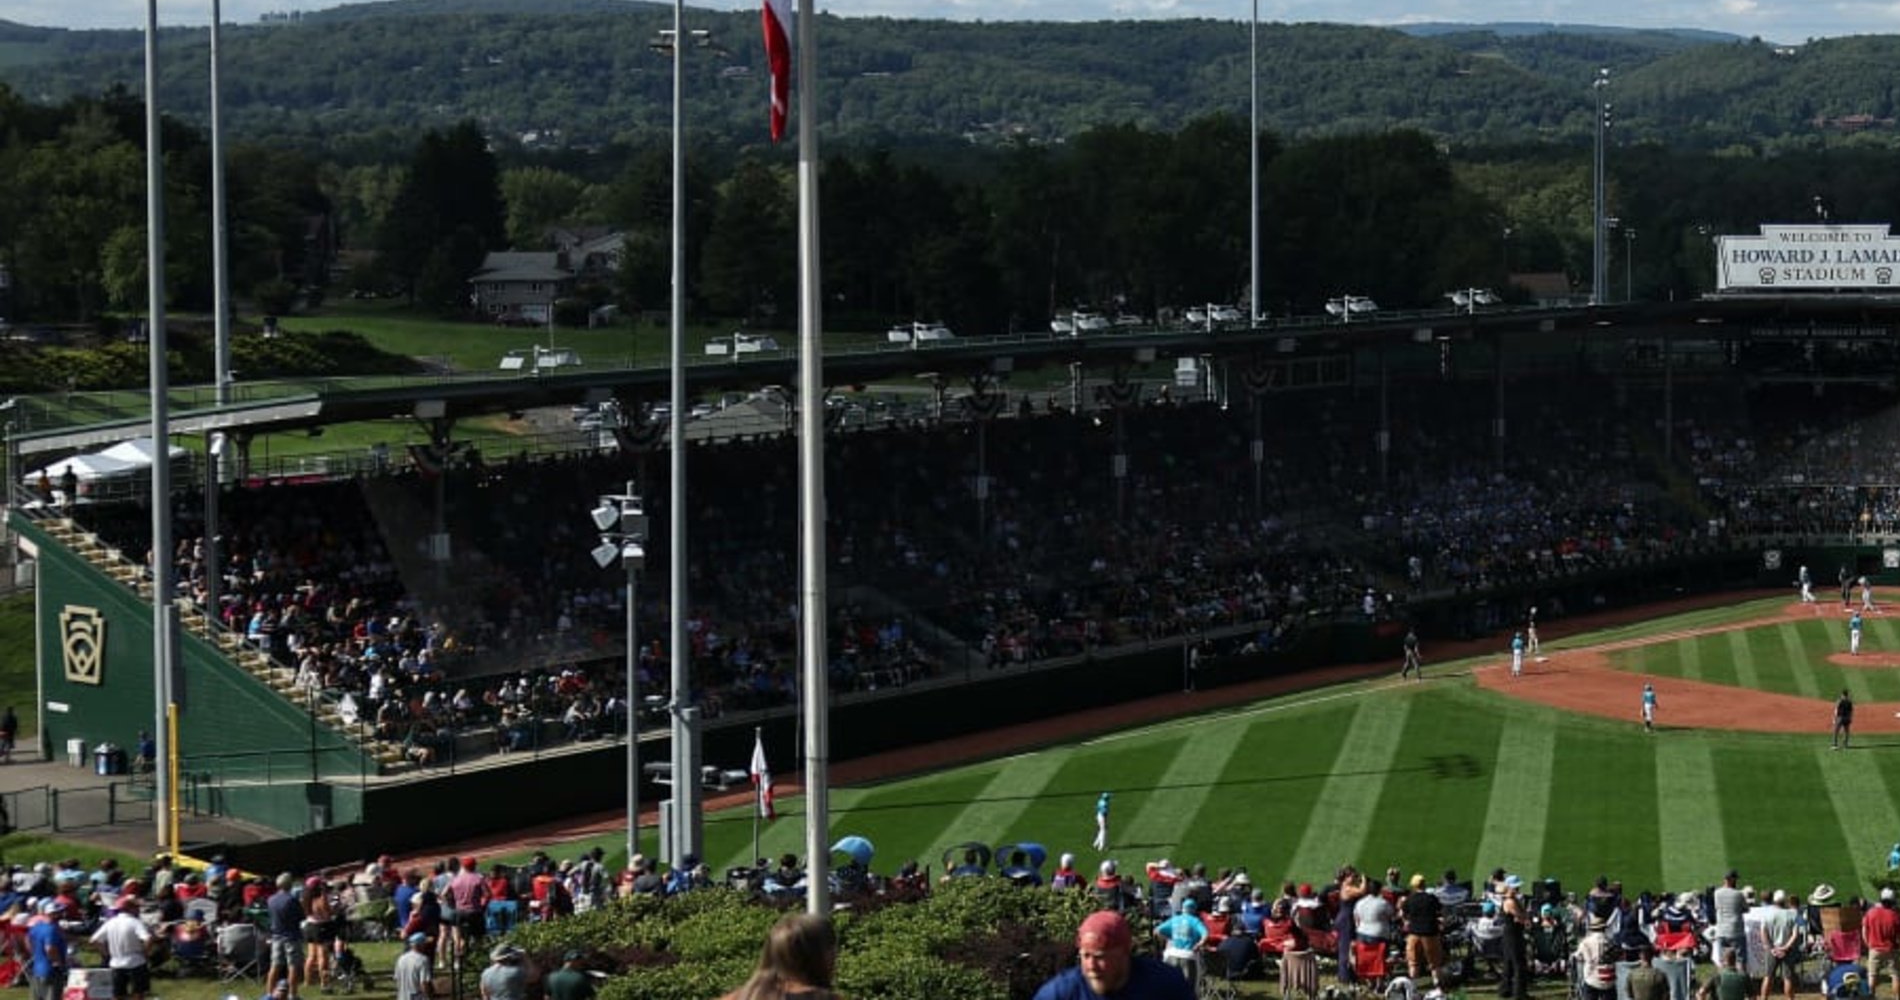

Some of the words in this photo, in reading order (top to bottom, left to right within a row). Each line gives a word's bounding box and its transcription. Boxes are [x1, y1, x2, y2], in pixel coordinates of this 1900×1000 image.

[1779, 232, 1849, 243] WELCOME
[1853, 232, 1872, 243] TO
[1732, 249, 1815, 264] HOWARD
[1782, 268, 1866, 281] STADIUM
